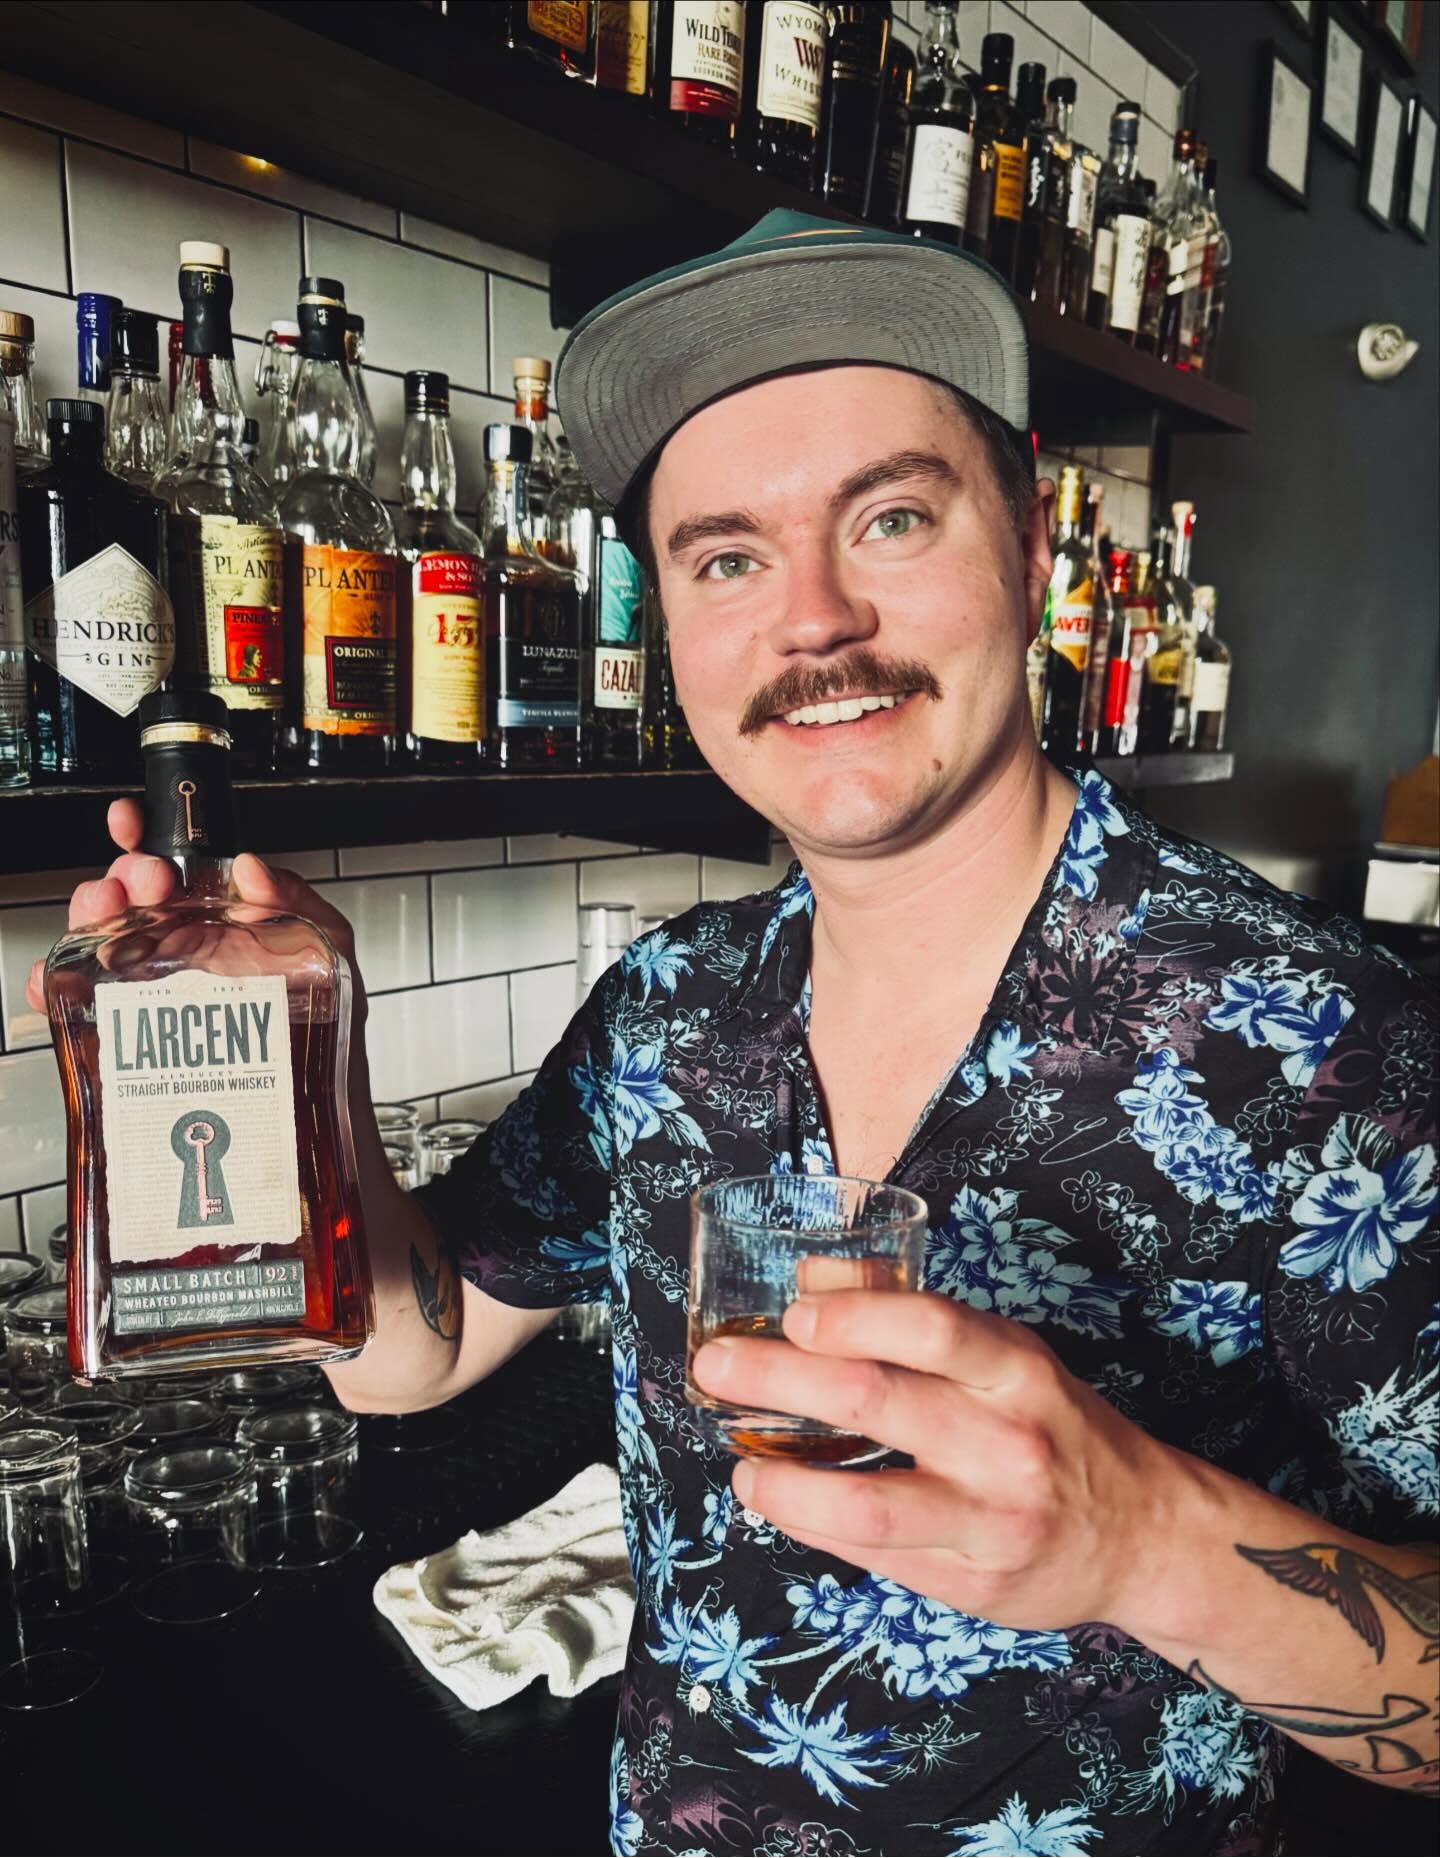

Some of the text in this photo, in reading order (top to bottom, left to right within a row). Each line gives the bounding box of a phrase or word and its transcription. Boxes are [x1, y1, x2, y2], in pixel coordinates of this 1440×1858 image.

[686, 17, 720, 45] WILD
[97, 652, 144, 667] GIN
[522, 645, 580, 661] LUNAZUL
[112, 1001, 272, 1072] LARCENY
[117, 1075, 277, 1098] STRAIGHT BOURBON WHISKEY
[160, 1070, 235, 1081] KENTUCKY
[122, 1266, 288, 1295] SMALL BATCH 92
[124, 1286, 295, 1311] WHEATED BOURBON MASHBILL
